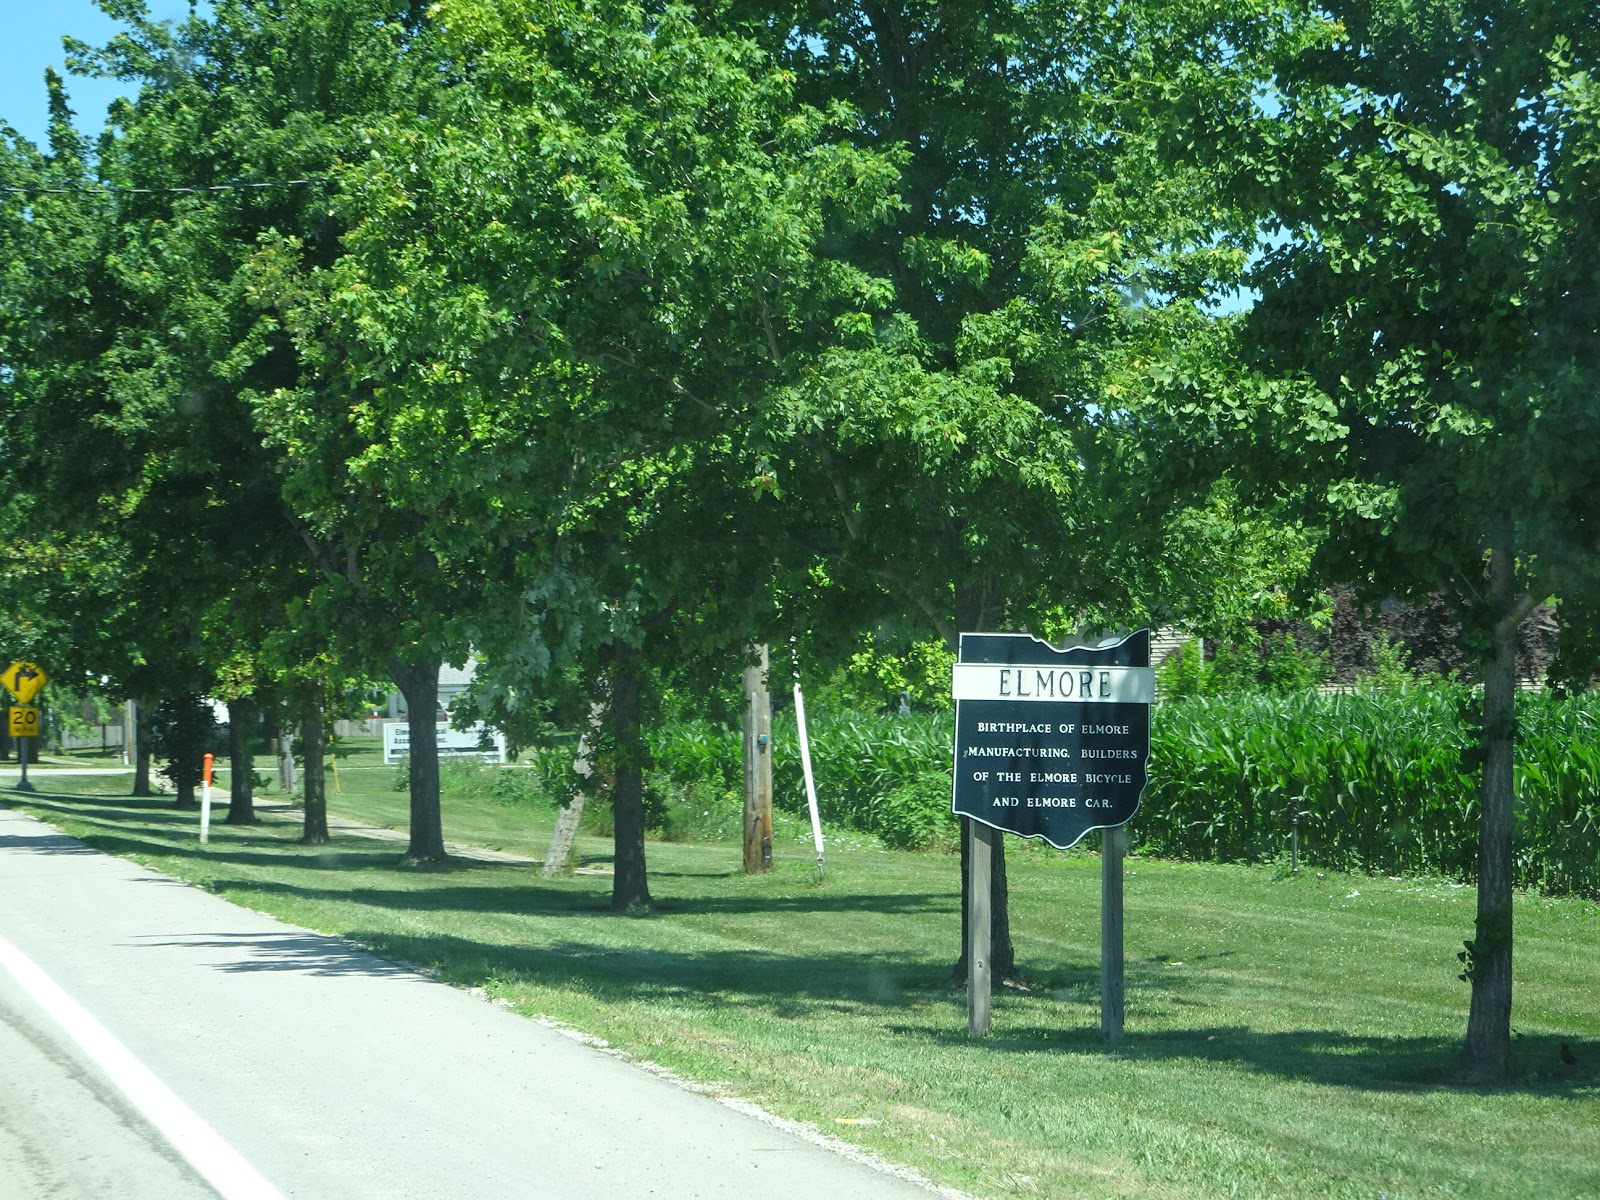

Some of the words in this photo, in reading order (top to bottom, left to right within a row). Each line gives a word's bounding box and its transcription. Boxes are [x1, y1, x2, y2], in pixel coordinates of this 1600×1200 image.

[999, 669, 1112, 698] ELMORE
[13, 711, 36, 725] 20
[977, 722, 1052, 734] BIRTHPLACE
[1059, 723, 1075, 734] OF
[1081, 724, 1129, 735] ELMORE
[967, 746, 1070, 759] MANUFACTURING.
[1081, 749, 1138, 760] BUILDERS
[973, 771, 989, 782] OF
[996, 772, 1022, 782] THE
[1030, 772, 1078, 783] ELMORE
[1085, 773, 1132, 784] BICYCLE
[992, 797, 1019, 807] AND
[1026, 797, 1076, 808] ELMORE
[1085, 798, 1113, 808] CAR.
